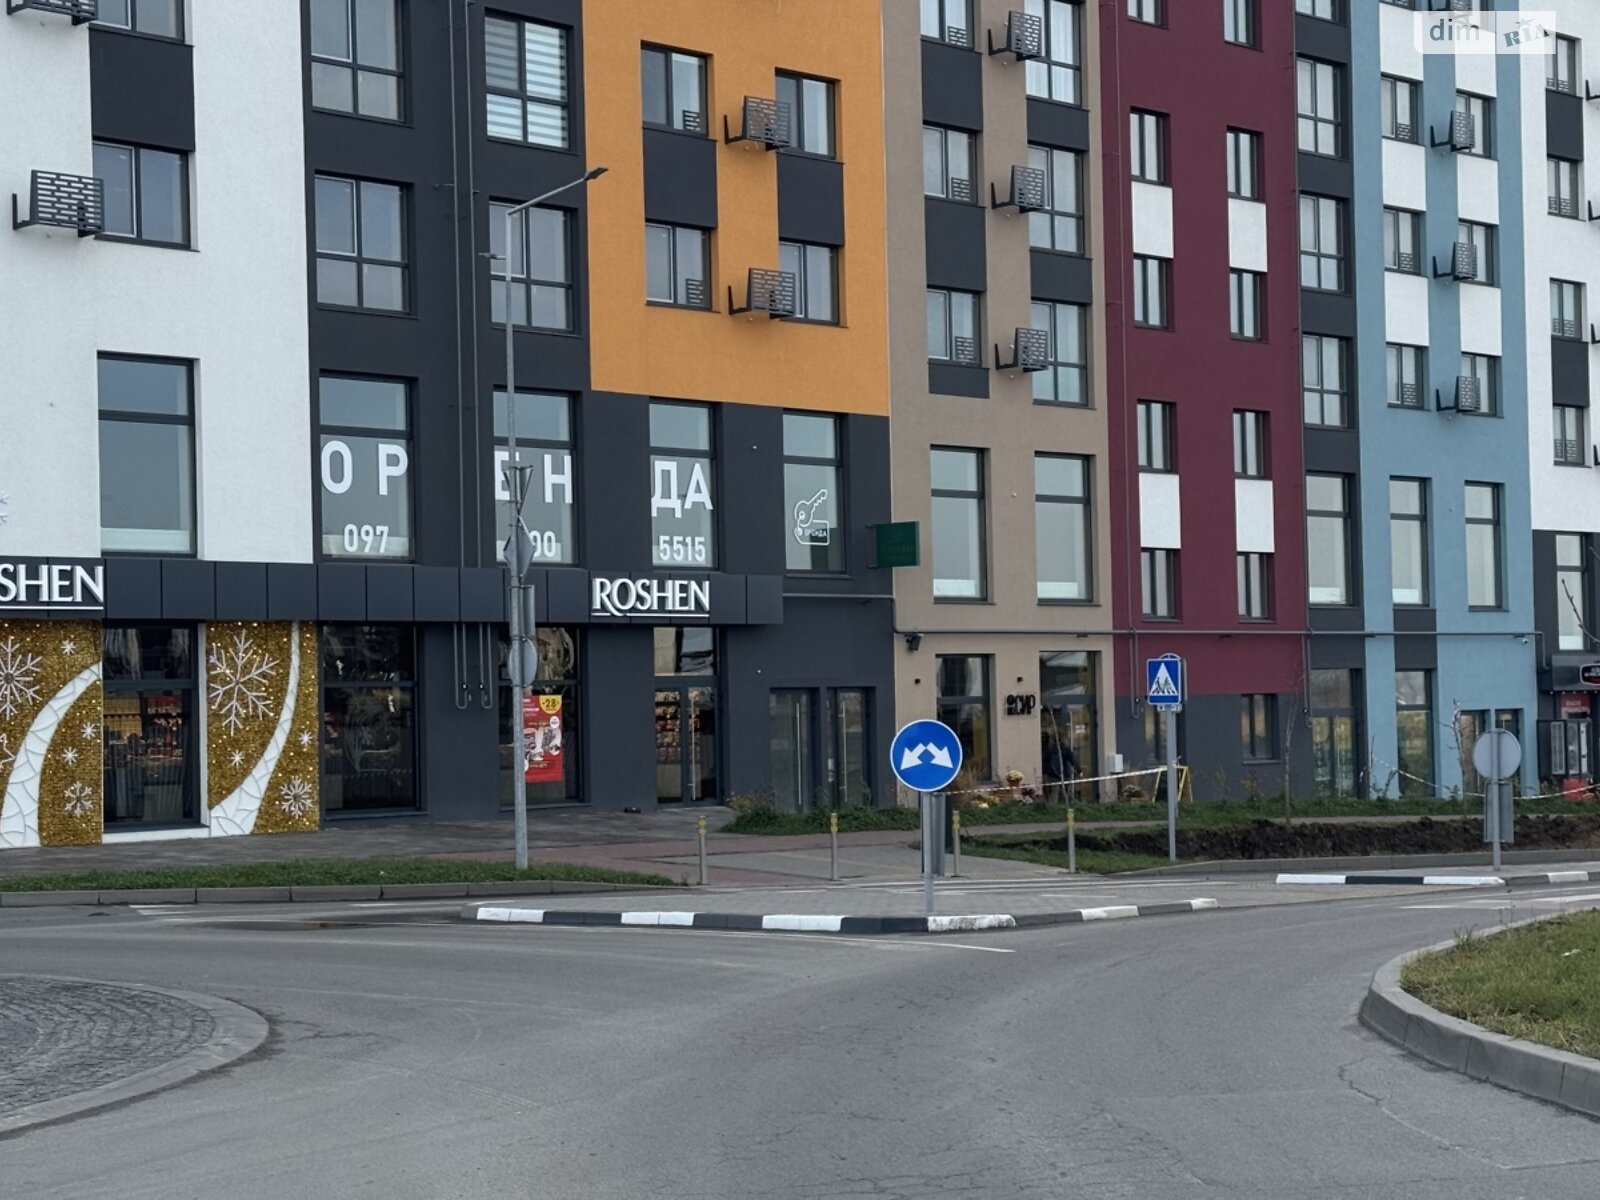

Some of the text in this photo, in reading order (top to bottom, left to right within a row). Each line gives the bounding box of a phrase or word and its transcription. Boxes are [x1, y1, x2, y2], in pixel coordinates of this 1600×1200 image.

[344, 523, 389, 553] 097
[659, 535, 706, 562] 5515
[592, 577, 710, 617] ROSHEN
